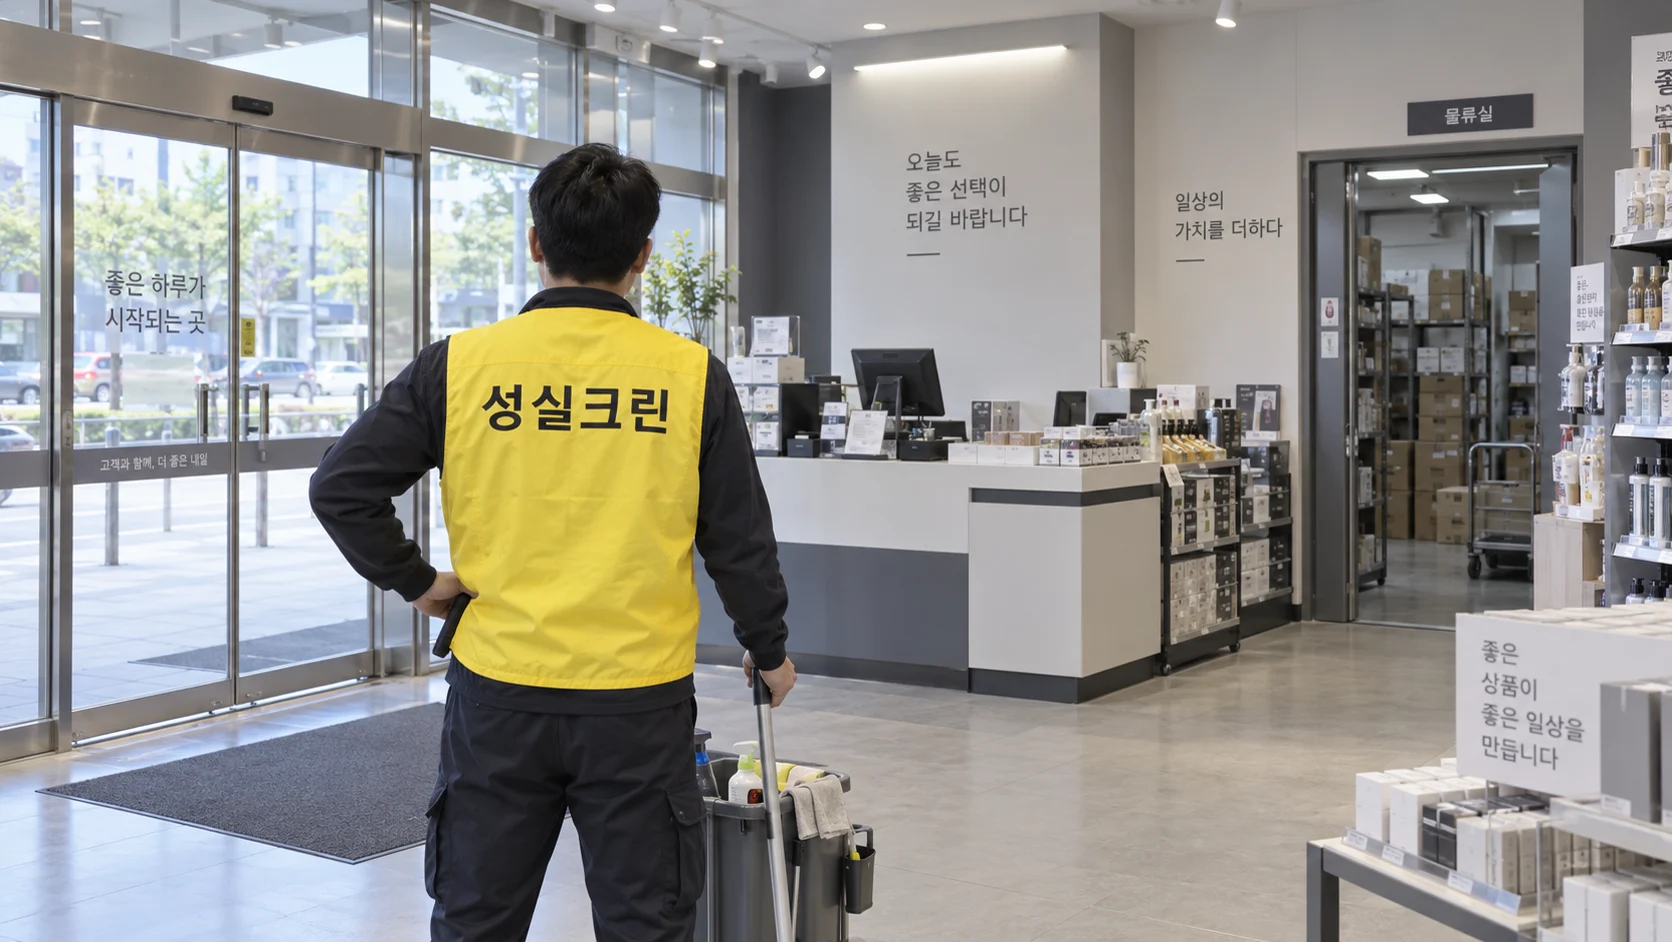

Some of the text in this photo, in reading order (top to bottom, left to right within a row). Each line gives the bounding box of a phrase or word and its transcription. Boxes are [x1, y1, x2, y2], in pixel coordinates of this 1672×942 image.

[1444, 104, 1493, 125] 물류실
[906, 150, 961, 171] 오늘도
[906, 176, 1005, 203] 좋은 선택이
[1175, 190, 1223, 212] 일상의
[906, 205, 1027, 232] 되길 바랍니다
[1175, 217, 1283, 241] 가치를 더하다
[105, 270, 206, 299] 좋은 하루가
[105, 307, 206, 334] 시작되는 곳
[482, 384, 669, 434] 성실크린
[100, 458, 130, 471] 고객과
[157, 455, 167, 468] 더
[190, 452, 208, 466] 내일
[1481, 639, 1519, 666] 좋은
[1481, 672, 1537, 701] 상품이
[1481, 702, 1585, 743] 좋은 일상을
[1482, 735, 1558, 771] 만듭니다
